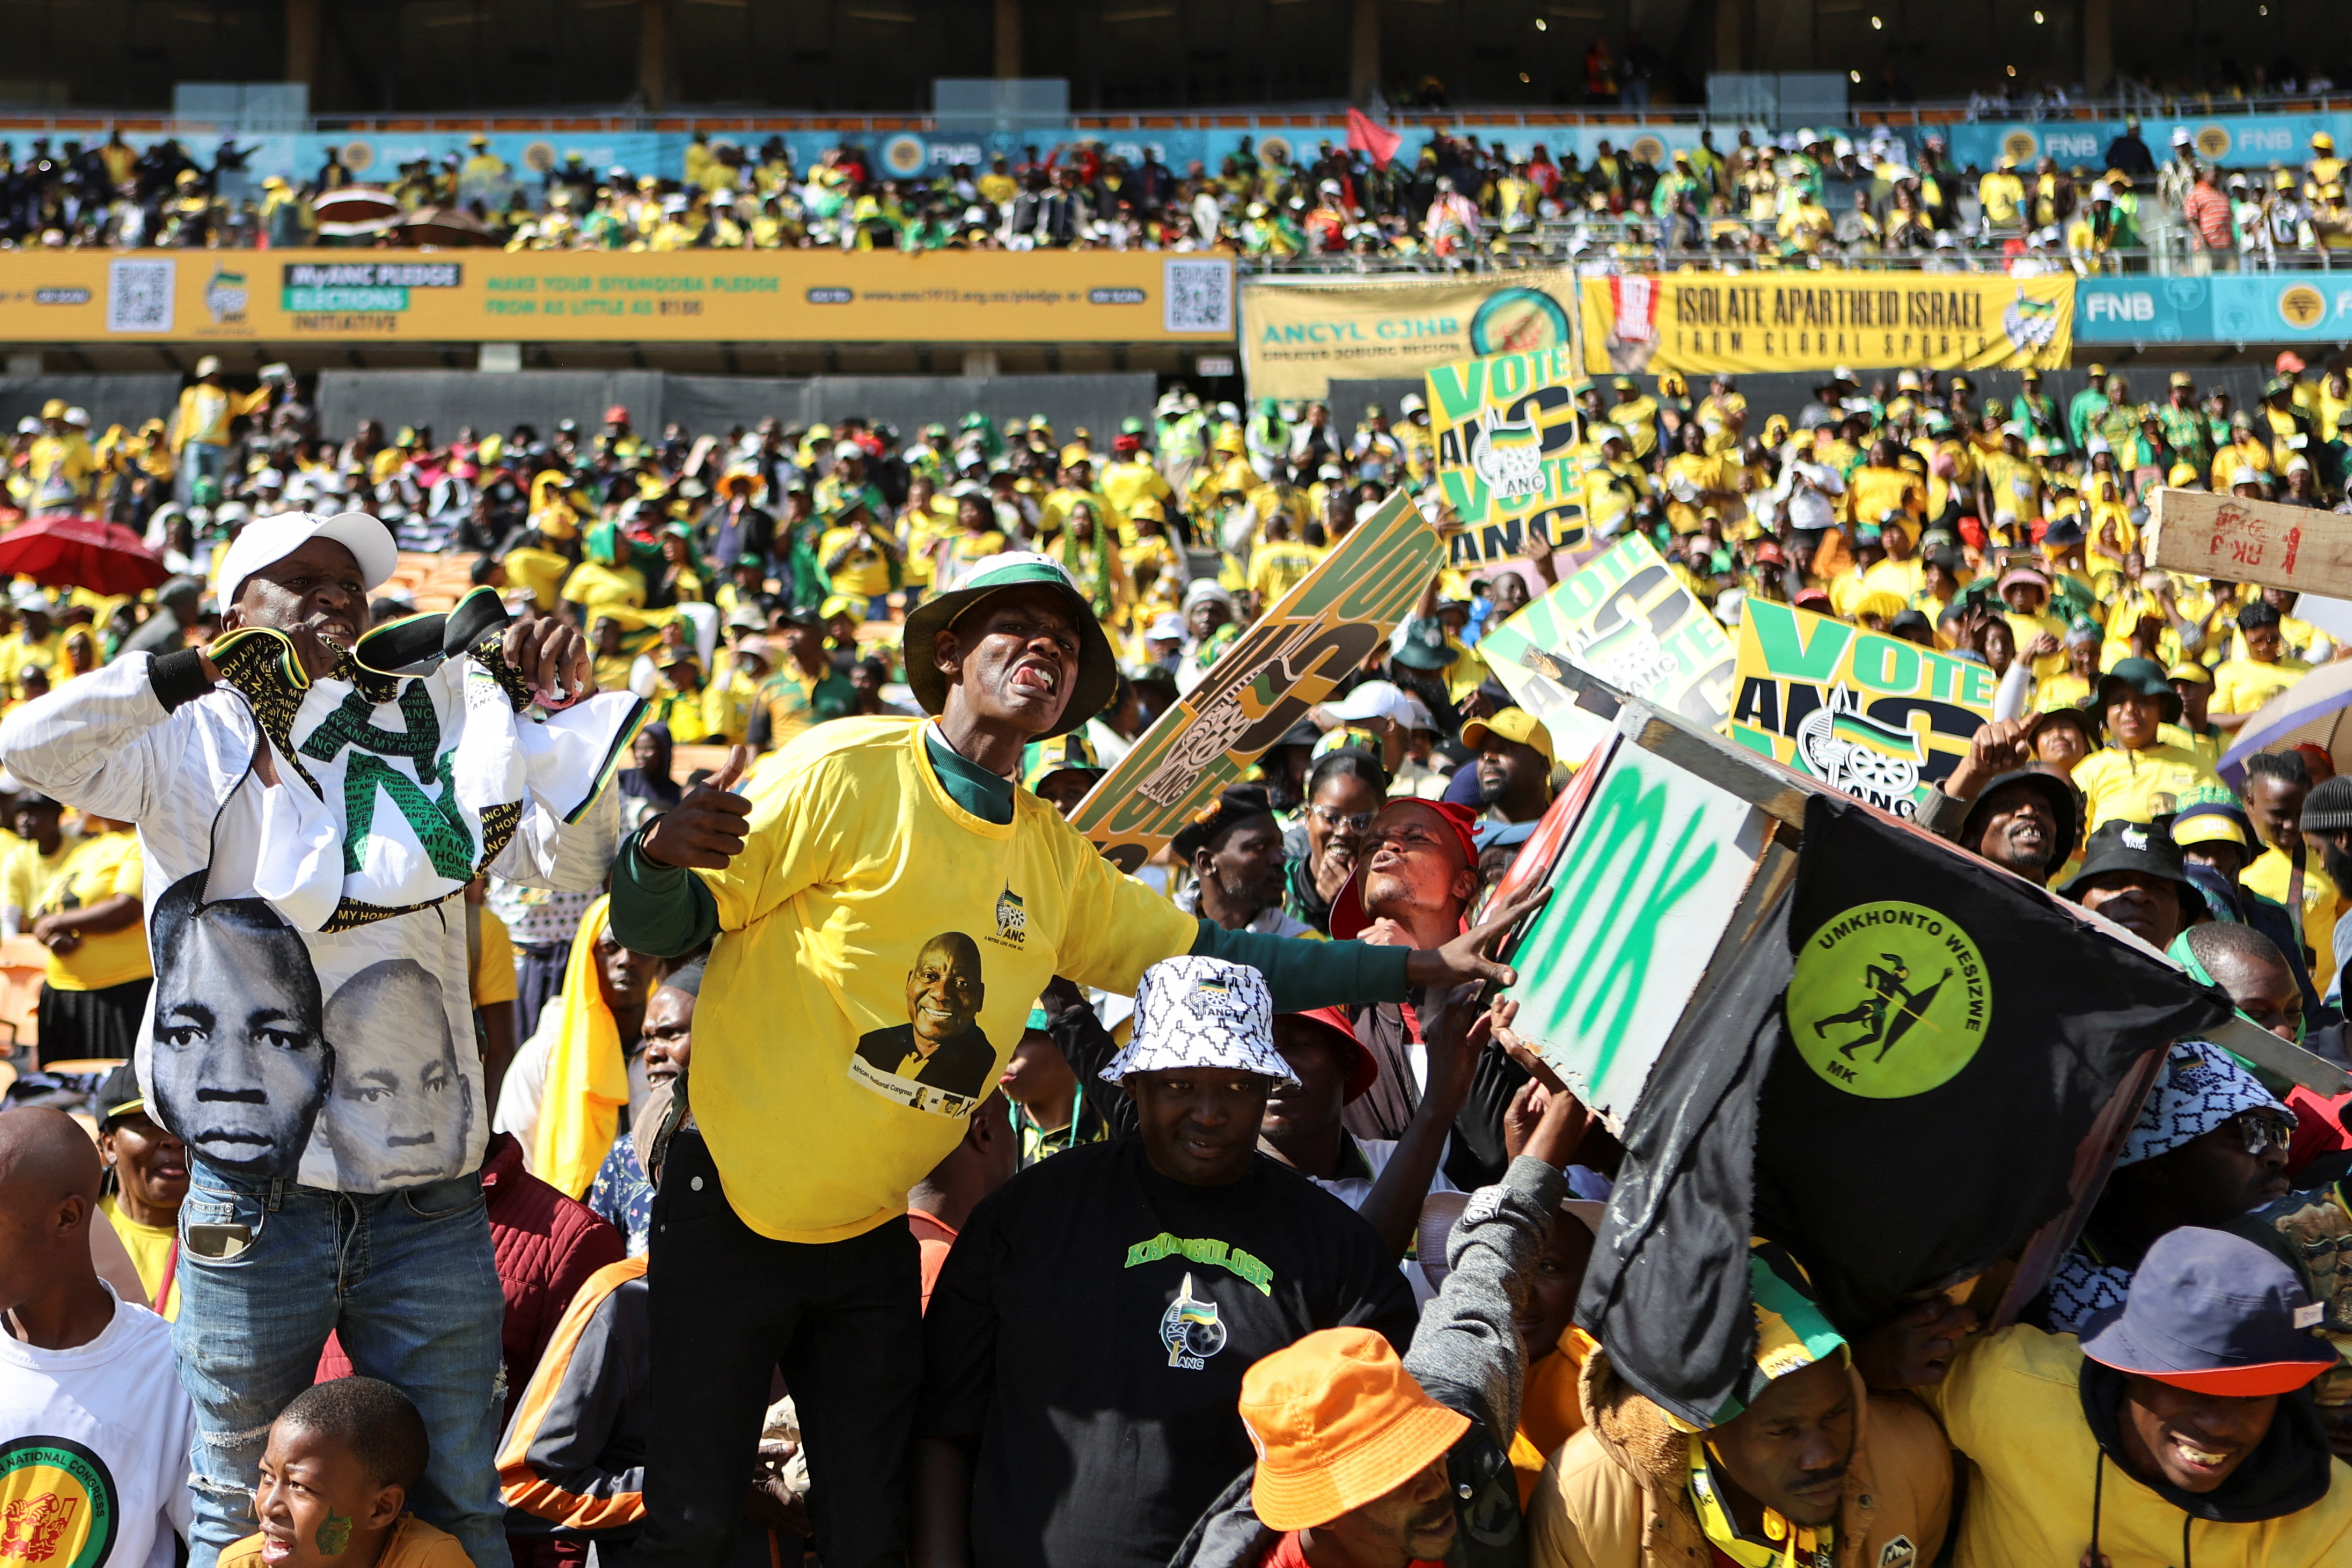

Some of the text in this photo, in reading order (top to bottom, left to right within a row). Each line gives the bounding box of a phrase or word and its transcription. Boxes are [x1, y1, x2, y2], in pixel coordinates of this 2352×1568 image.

[2045, 132, 2098, 157] FNB
[2239, 127, 2293, 150] FNB
[928, 144, 982, 166] FNB
[291, 264, 457, 288] MyANC PLEDGE
[487, 277, 536, 292] MAKE
[544, 276, 592, 292] YOUR
[712, 276, 780, 292] PLEDGE
[293, 289, 404, 311] ELECTIONS
[487, 300, 536, 315] FROM
[571, 300, 624, 315] LITTLE
[1676, 287, 1766, 326] ISOLATE
[1776, 288, 1899, 327] APARTHEID
[1907, 289, 1983, 329] ISRAEL
[2086, 291, 2155, 322] FNB
[293, 316, 396, 331] INITIATIVE
[1262, 317, 1461, 344] ANCYL GJHB
[1403, 343, 1461, 357] REGION
[1676, 331, 1745, 356] FROM
[1764, 331, 1863, 357] GLOBAL
[1428, 347, 1571, 423] VOTE
[1440, 457, 1582, 525] VTE
[1506, 475, 1546, 496] ANC
[1451, 505, 1587, 565] ANC
[1477, 538, 1653, 665] VOTE
[1746, 599, 1994, 706] VOTE
[1625, 655, 1680, 695] ANC
[288, 688, 303, 700] MY
[473, 695, 495, 711] ANC
[404, 708, 433, 720] ANC
[318, 730, 329, 738] MY
[321, 724, 333, 732] MY
[343, 726, 371, 744] ANC
[373, 737, 395, 750] MY
[398, 740, 435, 752] HOME
[367, 726, 384, 737] MY
[385, 732, 408, 741] ANC
[411, 733, 426, 741] MY
[307, 735, 334, 754] ANC
[317, 752, 330, 761] MY
[359, 782, 376, 791] ANC
[383, 778, 413, 786] HOME
[1144, 767, 1200, 807] ANC
[501, 802, 517, 814] MY
[1848, 781, 1918, 818] ANC
[480, 808, 502, 825] ANC
[421, 834, 475, 859] MY ANC
[2130, 842, 2147, 851] ANC
[434, 849, 472, 871] HOME
[441, 865, 457, 873] ANC
[337, 909, 396, 921] MY HOME
[1002, 928, 1025, 943] ANC
[1502, 765, 1718, 1097] MK
[1818, 909, 1985, 1032] UMKHONTO WESIZWE
[1207, 1008, 1235, 1018] ANC
[852, 1064, 913, 1097] African National Congress
[1826, 1060, 1859, 1084] MK
[1124, 1232, 1274, 1297] KHONGOLOSE
[1177, 1356, 1205, 1370] ANC
[1767, 1356, 1793, 1373] ANC
[6, 1451, 105, 1518] NATIONAL CONGRESS
